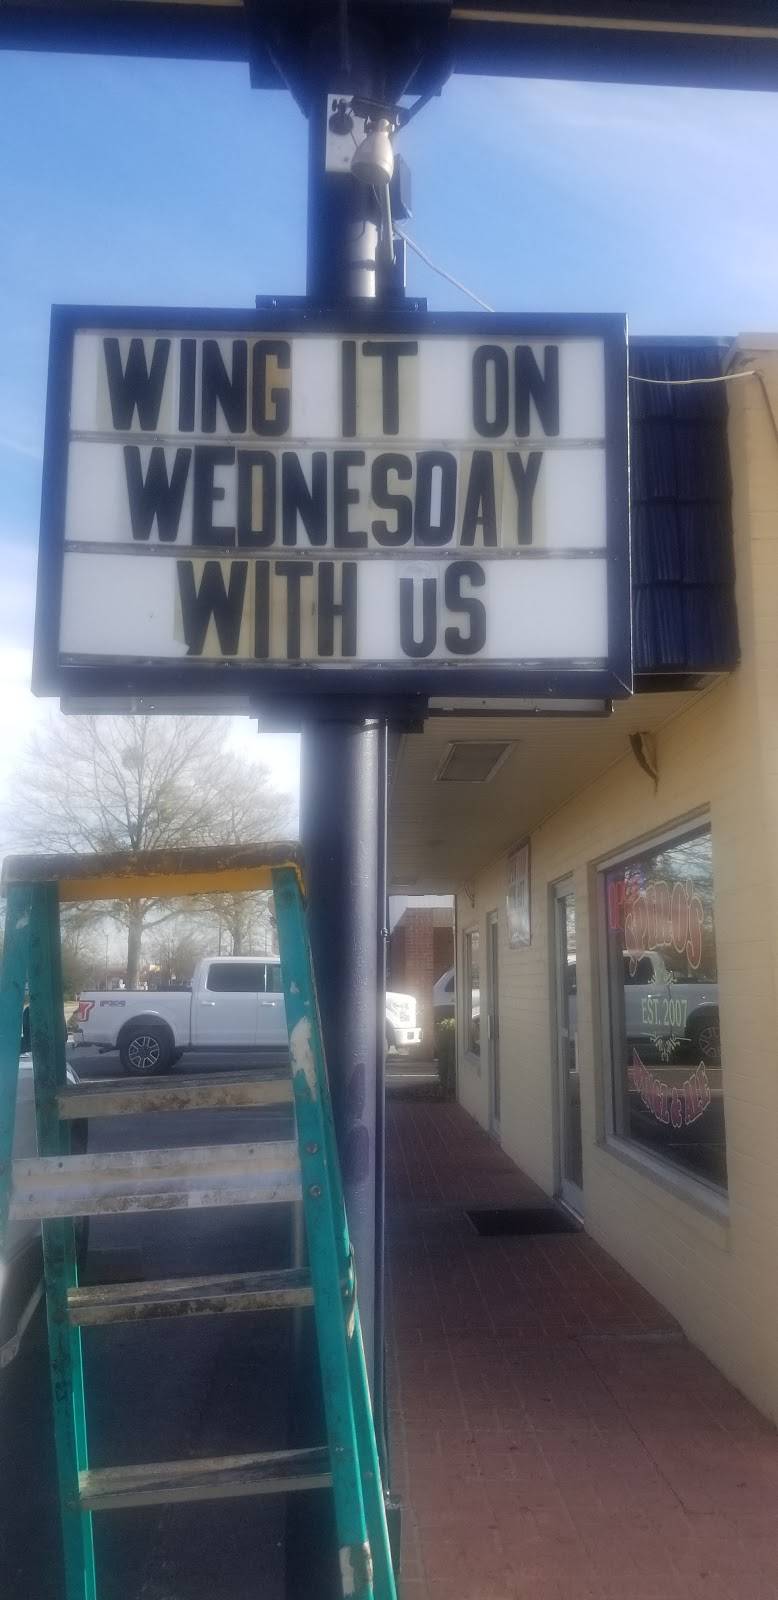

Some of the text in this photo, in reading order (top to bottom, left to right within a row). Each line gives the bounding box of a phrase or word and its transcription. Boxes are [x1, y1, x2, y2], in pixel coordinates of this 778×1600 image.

[103, 338, 560, 438] WING IT ON
[123, 446, 543, 547] WEDNESDAY
[177, 560, 358, 658] WITH
[641, 997, 688, 1027] EST. 2007
